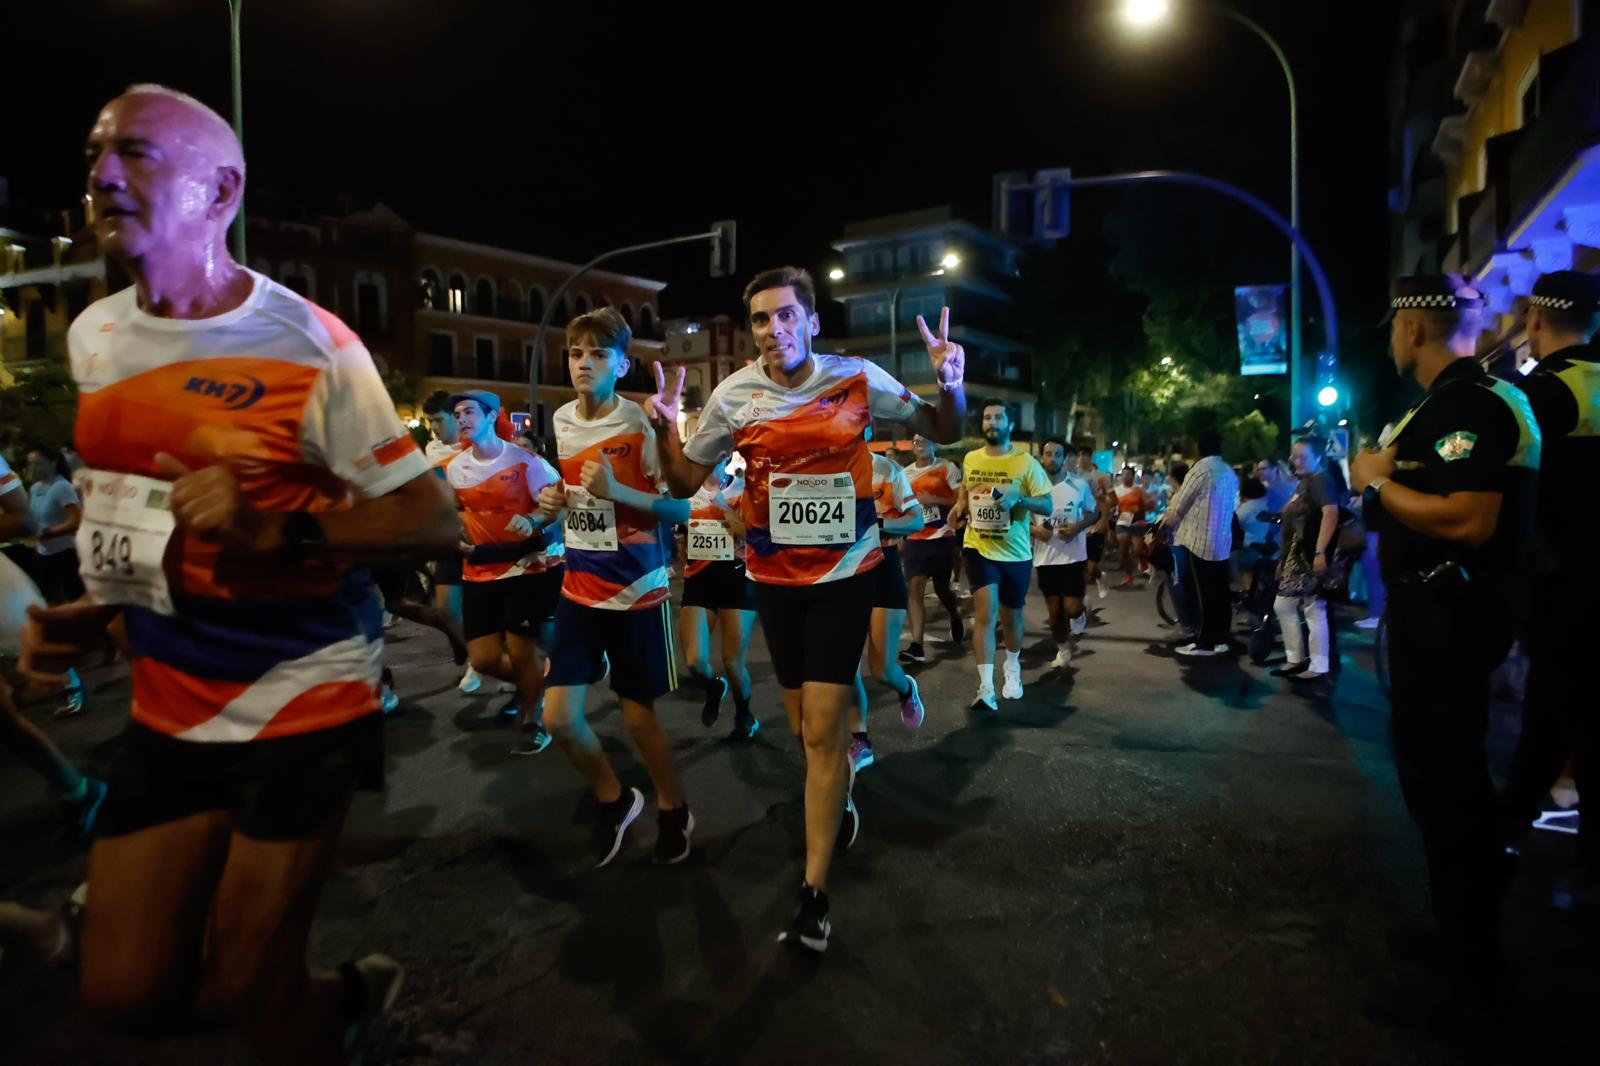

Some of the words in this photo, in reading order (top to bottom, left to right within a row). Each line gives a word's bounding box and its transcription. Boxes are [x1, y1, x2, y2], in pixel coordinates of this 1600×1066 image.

[184, 376, 248, 403] KH7
[567, 510, 607, 533] 20684
[778, 501, 845, 524] 20624
[976, 508, 1002, 521] 4603
[692, 535, 727, 549] 22511
